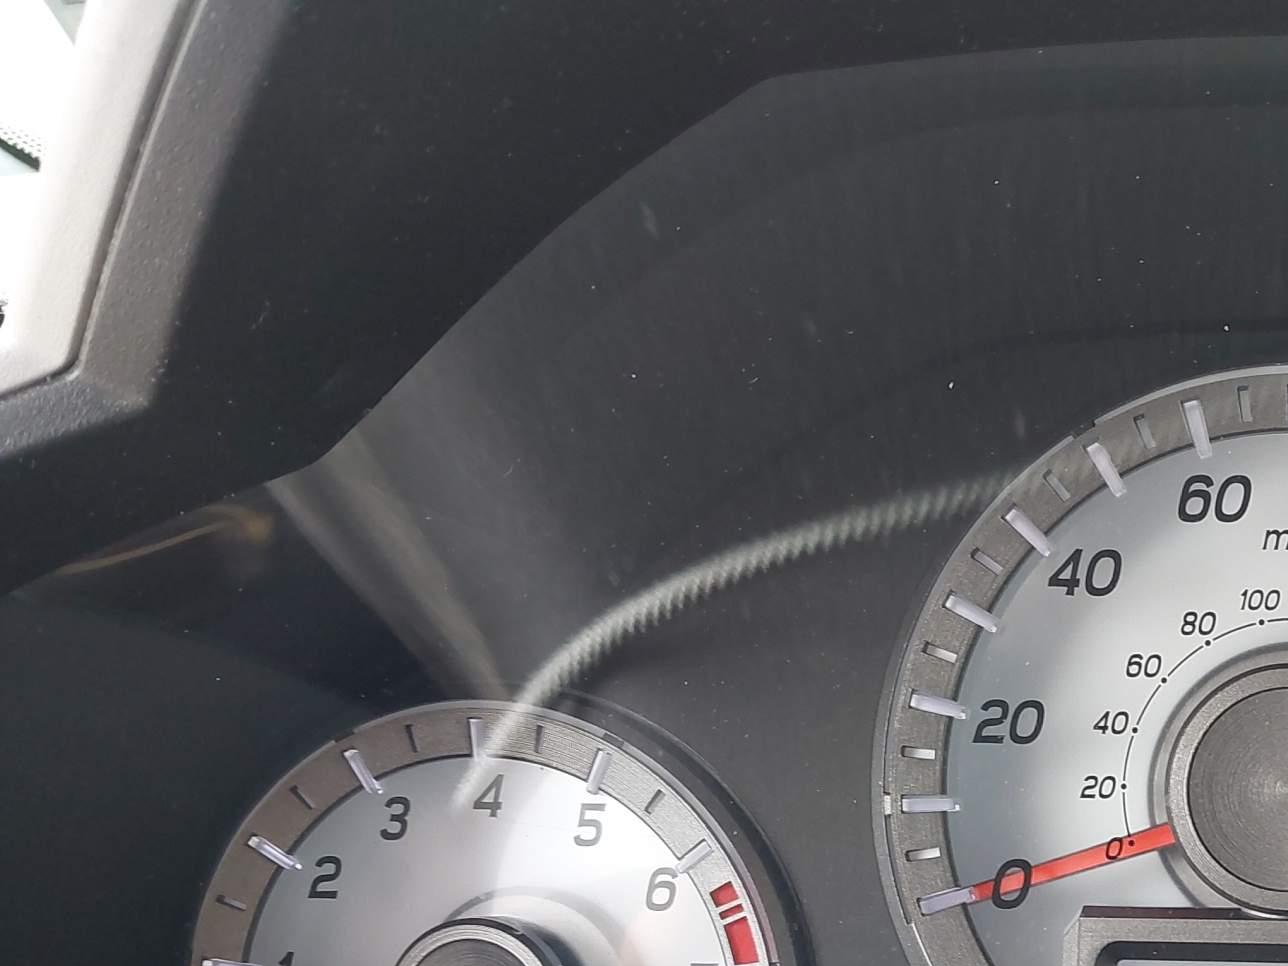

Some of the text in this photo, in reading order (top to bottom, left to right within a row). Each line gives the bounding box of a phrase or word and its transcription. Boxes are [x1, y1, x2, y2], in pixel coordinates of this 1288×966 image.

[1177, 473, 1253, 524] 60
[1047, 548, 1123, 598] 40
[1239, 588, 1282, 611] 100
[1180, 611, 1218, 636] 80
[1125, 653, 1163, 679] 60
[971, 698, 1046, 746] 20
[1092, 711, 1130, 736] 40
[473, 773, 506, 819] 4
[1079, 775, 1117, 800] 20
[379, 796, 411, 841] 3
[573, 802, 607, 847] 5
[1105, 836, 1123, 860] 0
[306, 855, 343, 900] 2
[644, 867, 678, 912] 6
[991, 857, 1033, 910] 0
